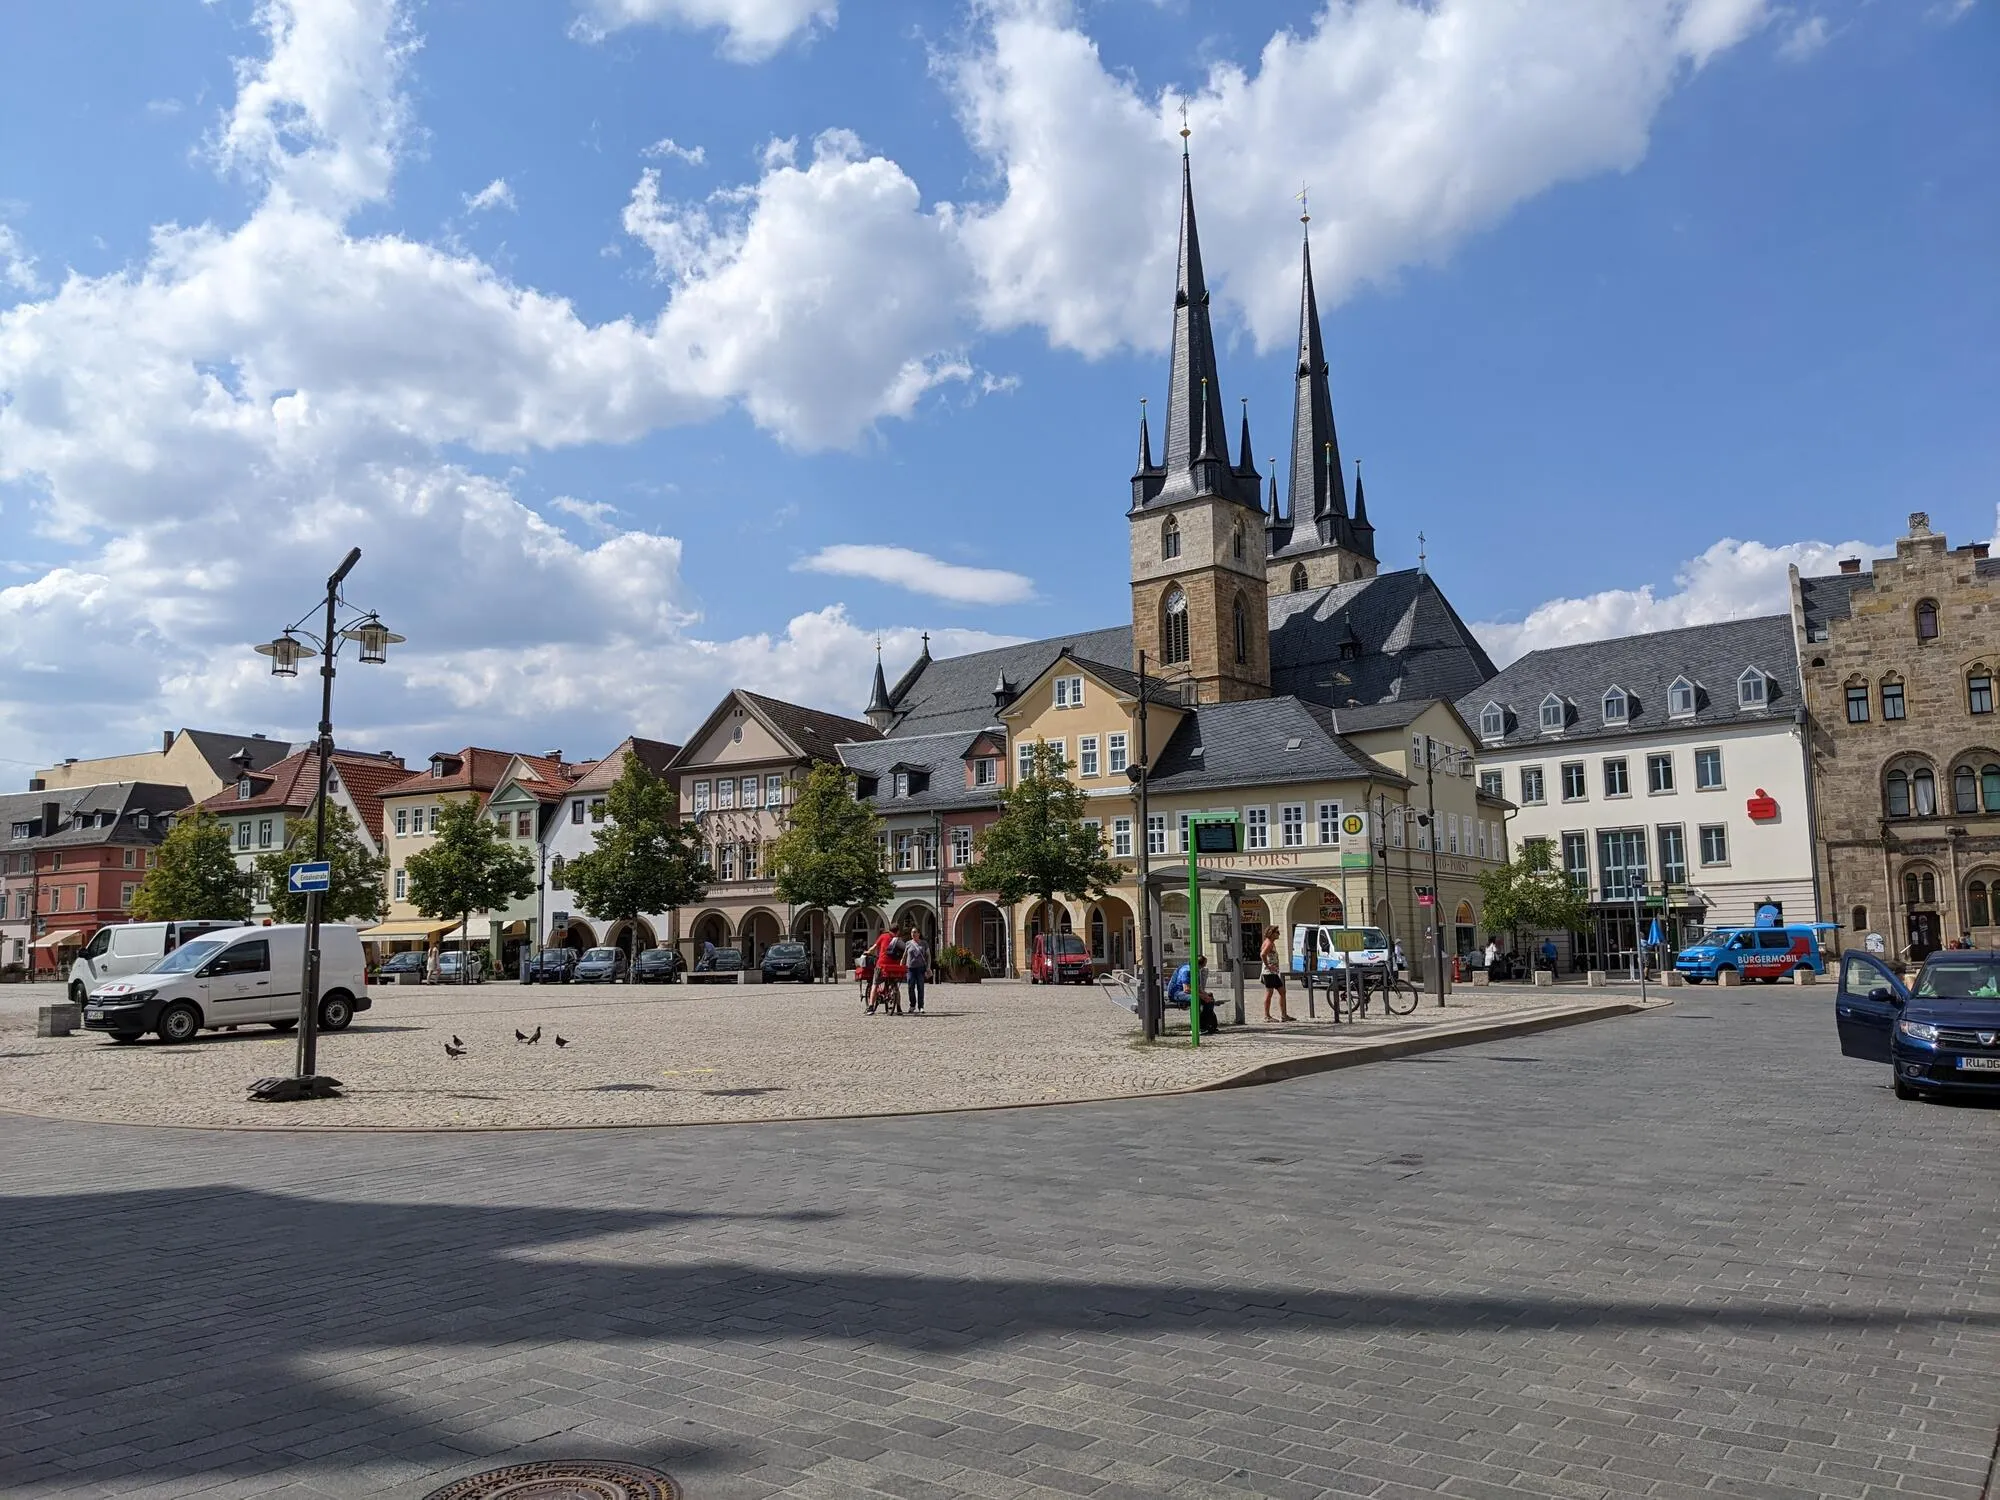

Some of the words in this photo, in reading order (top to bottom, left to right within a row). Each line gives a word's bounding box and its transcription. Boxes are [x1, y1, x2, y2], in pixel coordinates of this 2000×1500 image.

[1348, 819, 1356, 830] H
[1738, 954, 1798, 963] BÜRGERMOBIL
[1966, 1059, 1980, 1067] RU
